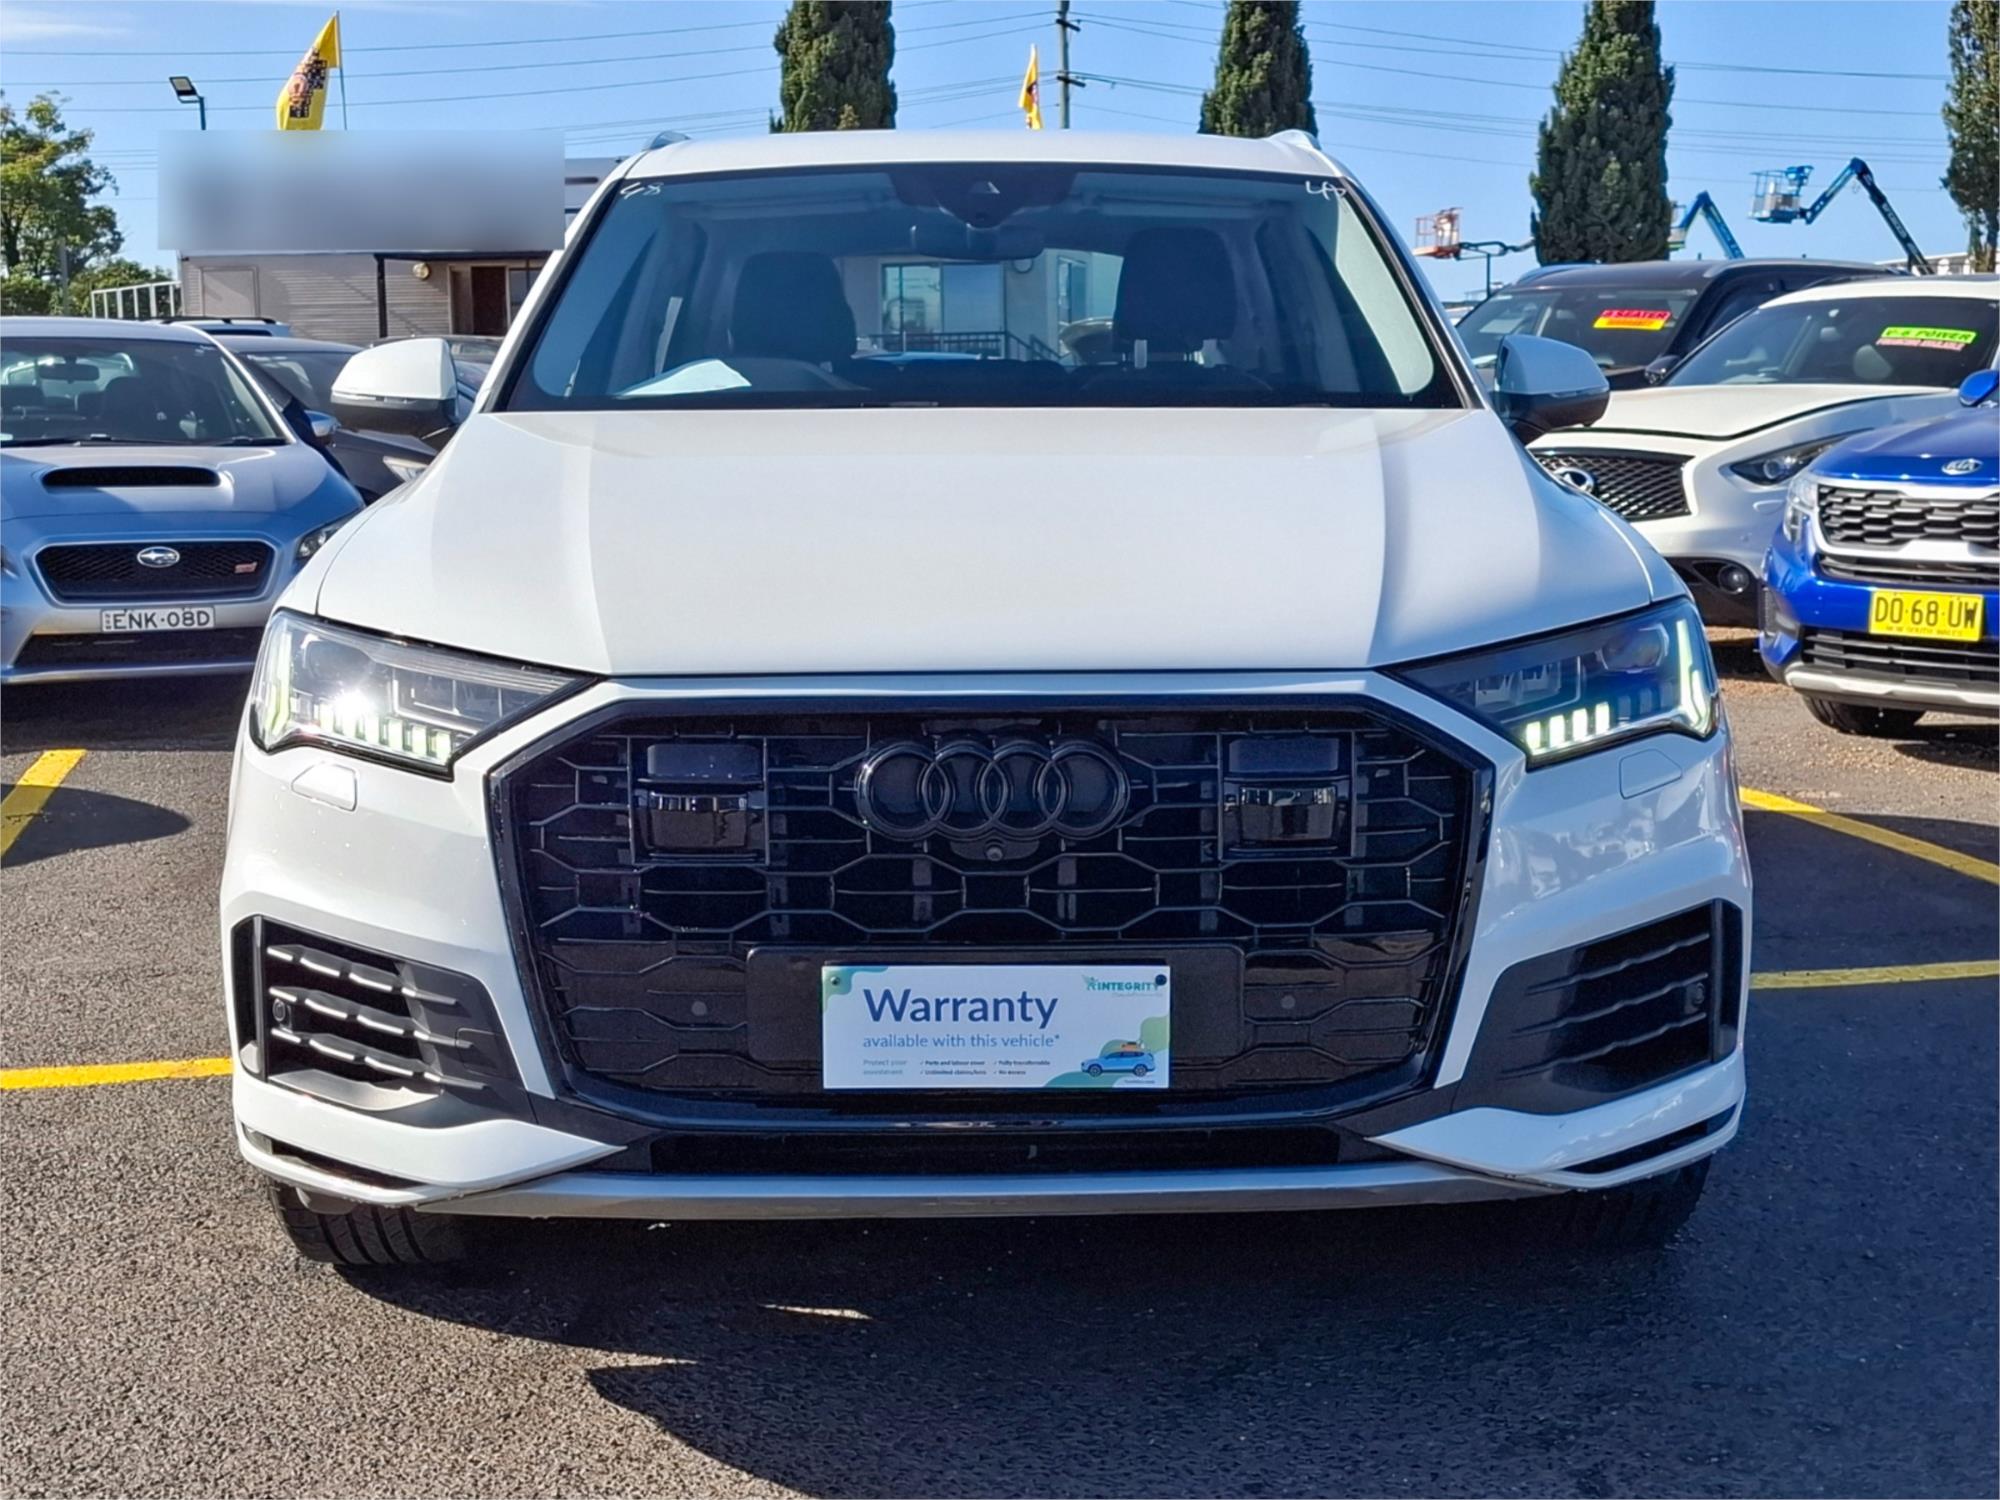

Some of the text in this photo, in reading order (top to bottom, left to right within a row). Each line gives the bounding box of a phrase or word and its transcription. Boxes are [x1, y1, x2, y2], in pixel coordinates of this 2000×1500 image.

[1915, 331, 1972, 341] POWER
[863, 988, 1059, 1029] Warranty
[863, 1033, 929, 1048] available
[932, 1033, 966, 1048] with
[970, 1033, 998, 1048] this
[863, 1059, 890, 1067] Protect
